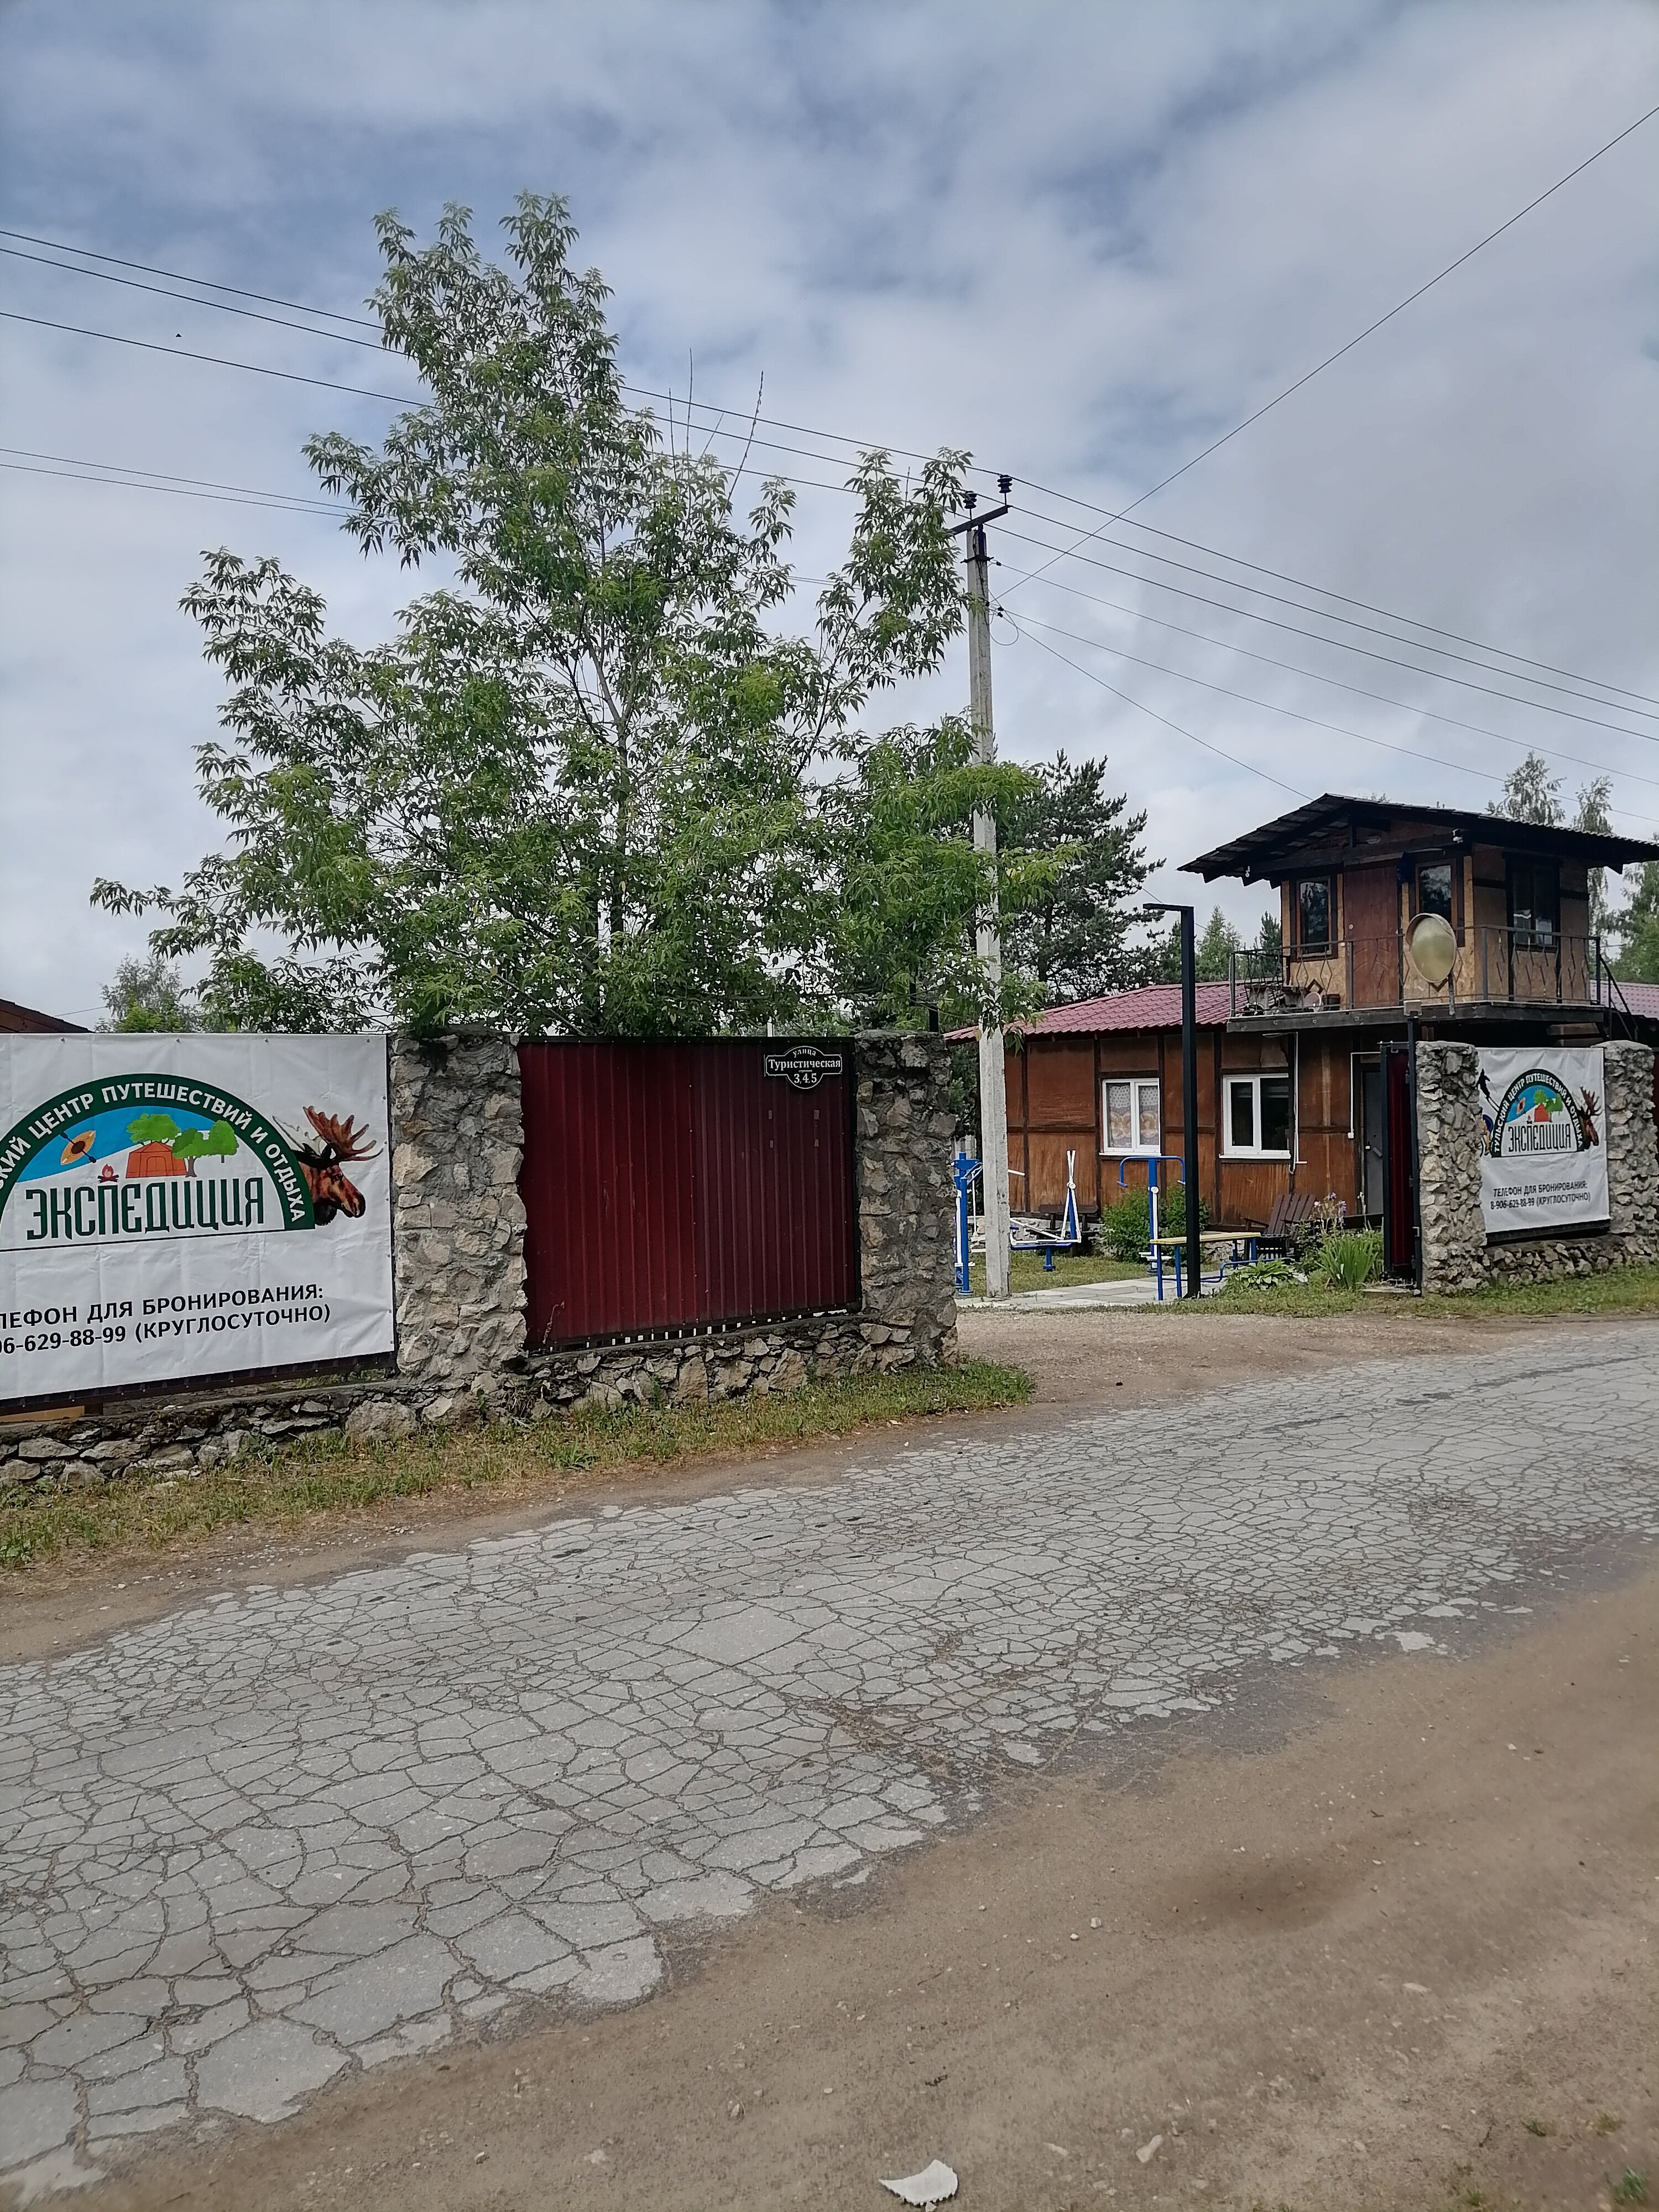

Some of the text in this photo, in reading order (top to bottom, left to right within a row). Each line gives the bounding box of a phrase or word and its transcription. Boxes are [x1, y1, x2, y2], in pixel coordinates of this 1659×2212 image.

[768, 1059, 841, 1071] Туристическая
[792, 1048, 816, 1058] улица
[1494, 1073, 1583, 1152] ТУЛЬСКИЙ ЦЕНТР ПУТЕШЕСТВИЙ И ОТДЫХА
[28, 1093, 93, 1139] ЦЕНТР
[102, 1082, 252, 1130] ПУТЕШЕСТВИЙ
[254, 1126, 268, 1141] И
[265, 1144, 305, 1222] ОТДЫХА
[1508, 1123, 1571, 1152] ЭКСПЕДИЦИЯ
[1493, 1181, 1588, 1197] ТЕЛЕФОН ДЛЯ БРОНИРОВАНИЯ:
[1536, 1192, 1590, 1207] (КРУГЛОСУТОЧНО)
[25, 1177, 264, 1240] ЭКСПЕДИЦИЯ
[87, 1301, 133, 1324] ДЛЯ
[143, 1284, 324, 1316] БРОНИРОВАНИЯ:
[0, 1303, 330, 1354] 6-629-88-99 (КРУГЛОСУТОЧНО)
